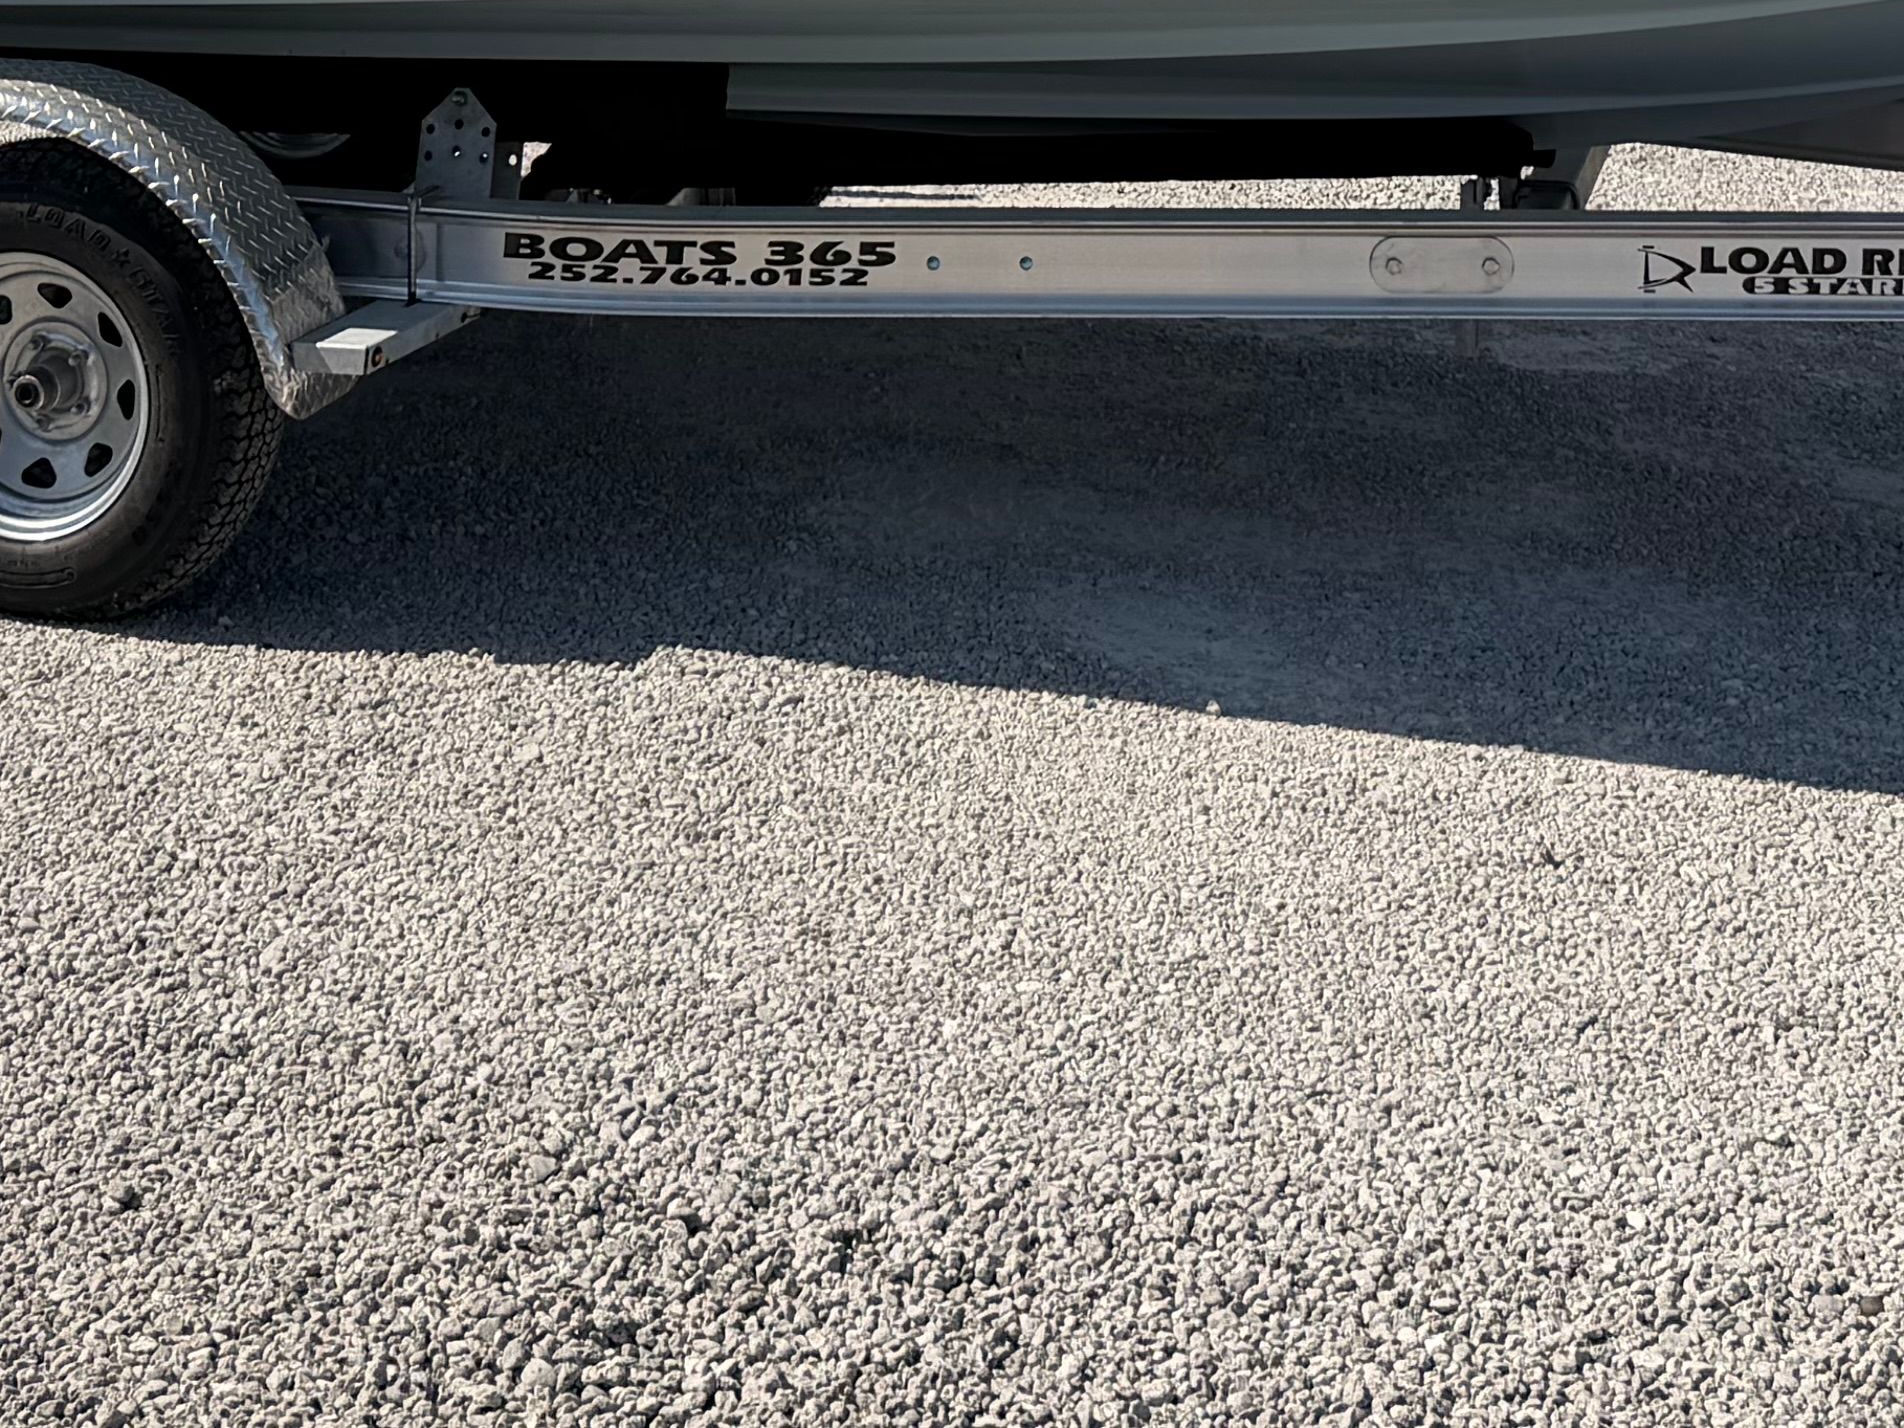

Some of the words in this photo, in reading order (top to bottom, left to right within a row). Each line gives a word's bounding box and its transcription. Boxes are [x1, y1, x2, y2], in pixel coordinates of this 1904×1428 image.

[503, 232, 738, 265] BOATS
[764, 241, 897, 267] 365
[1700, 246, 1847, 275] LOAD
[527, 261, 870, 287] 252.764.0152
[1753, 277, 1776, 294] 5
